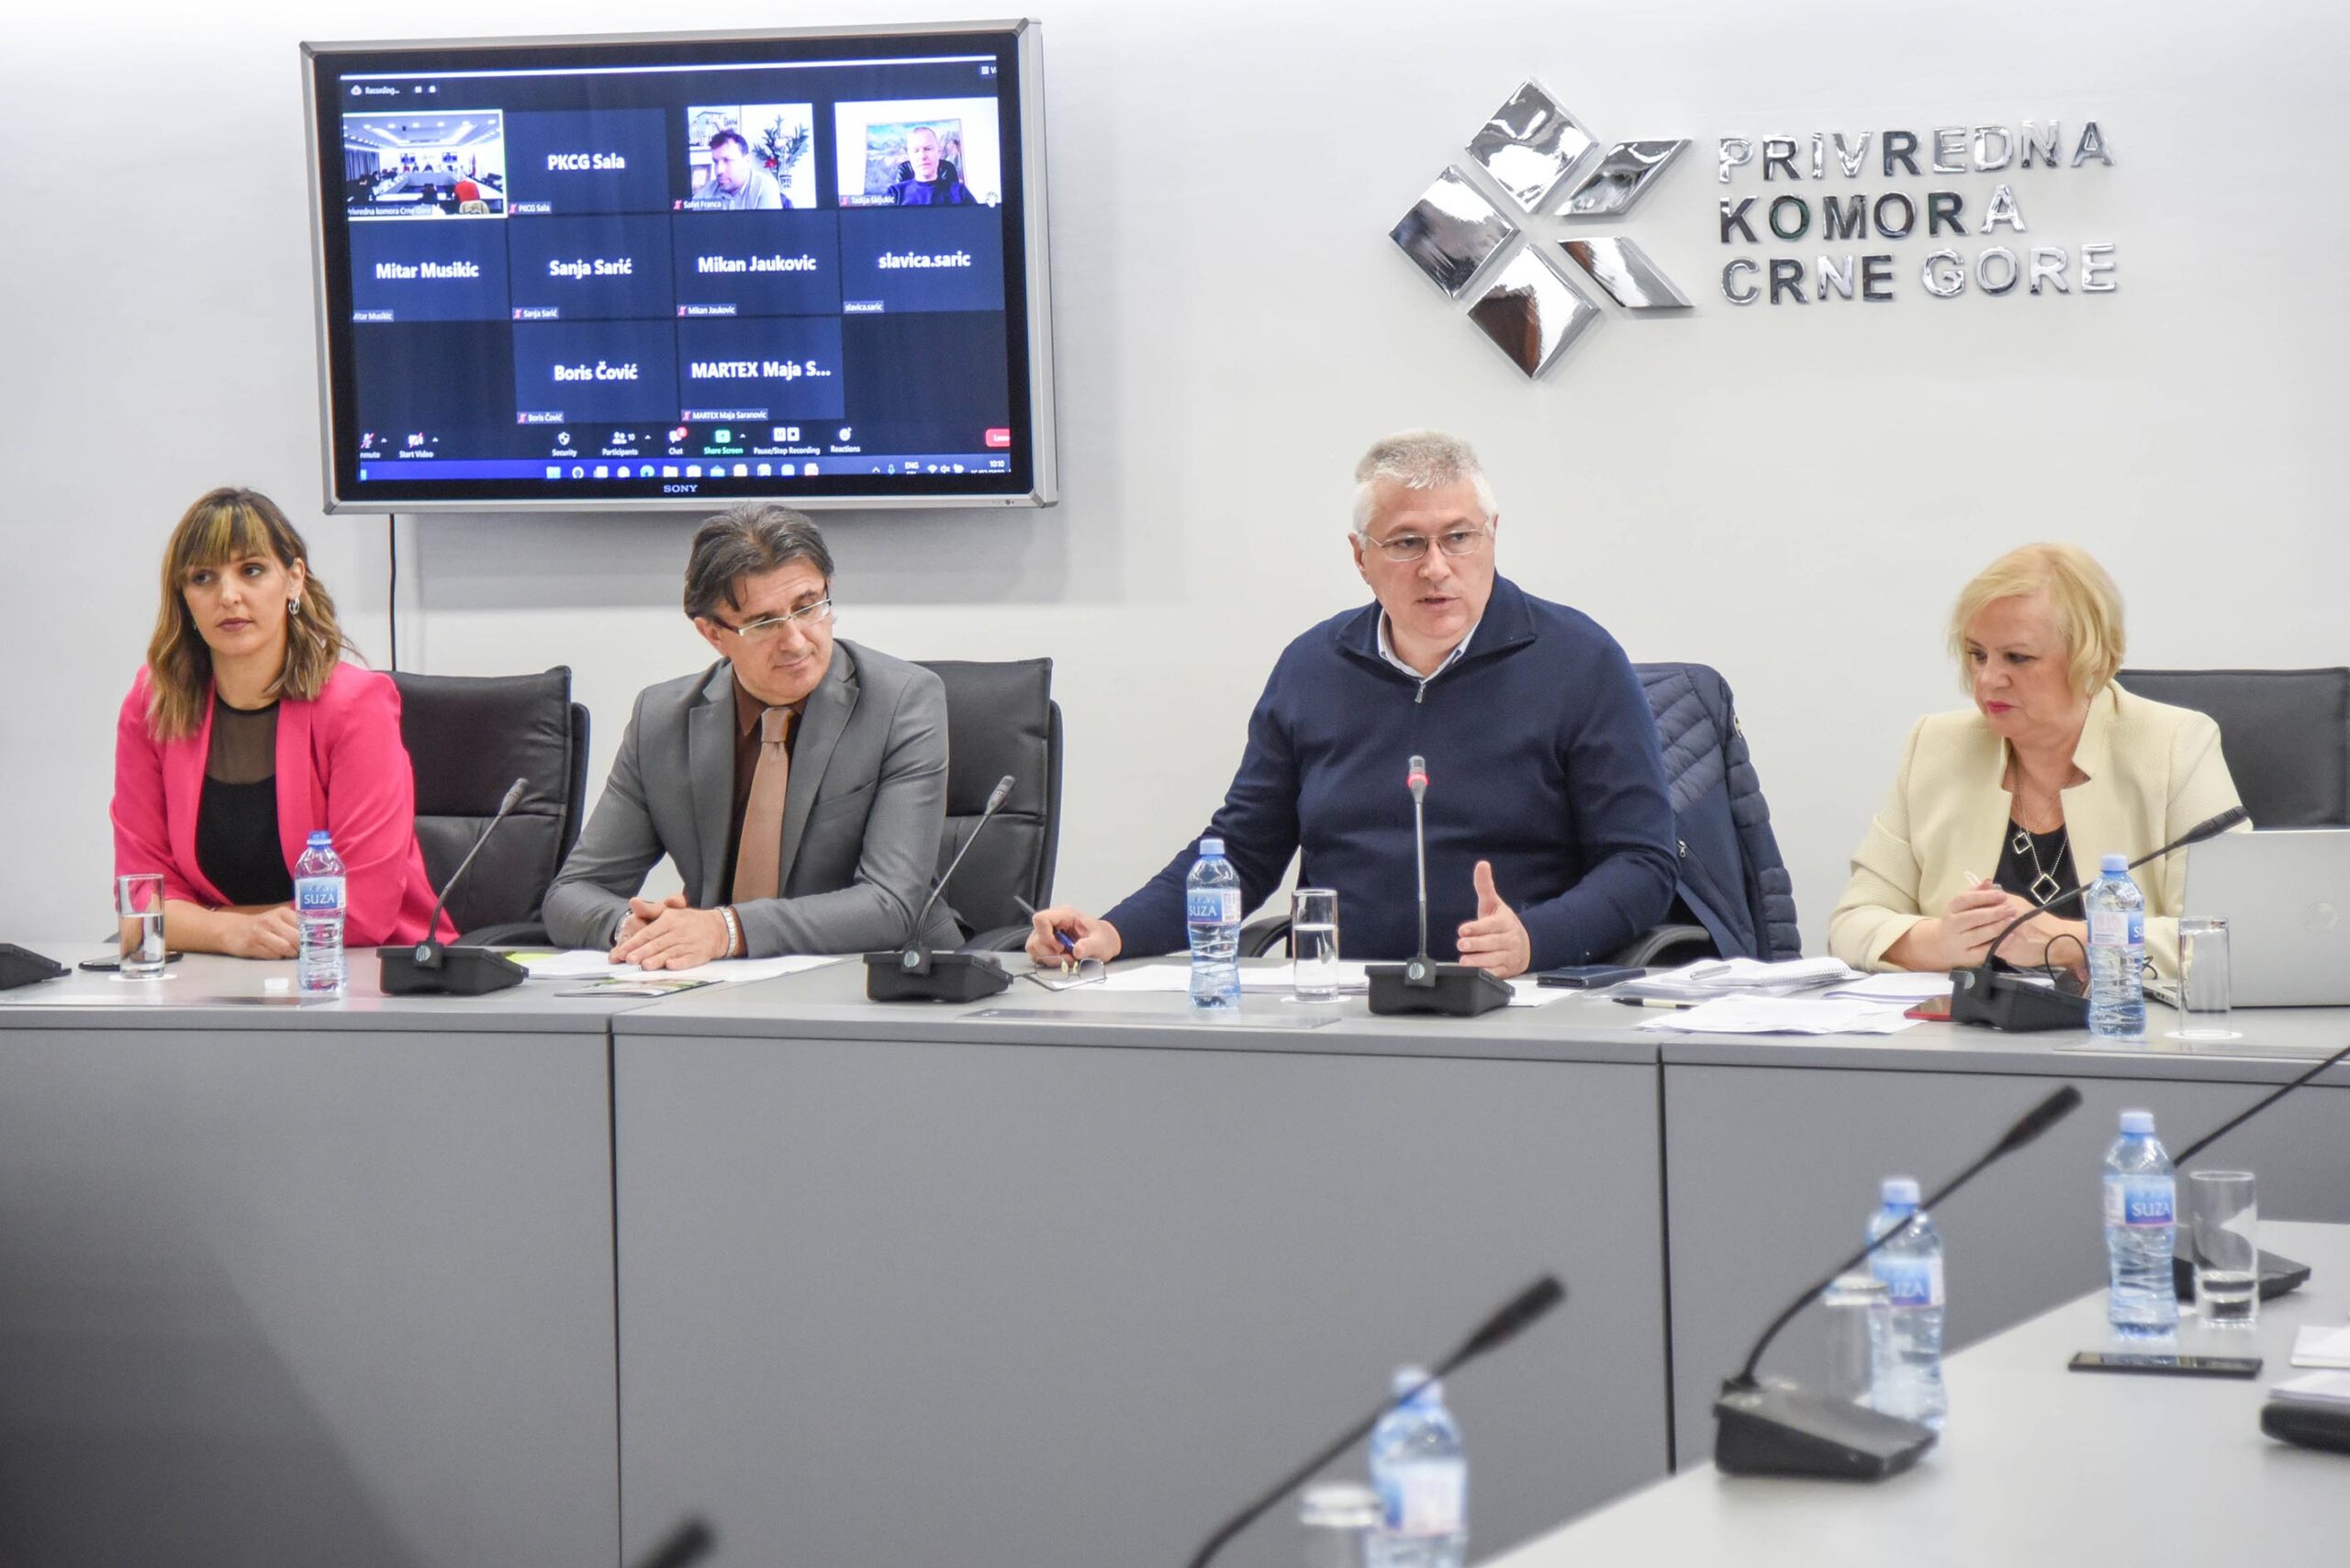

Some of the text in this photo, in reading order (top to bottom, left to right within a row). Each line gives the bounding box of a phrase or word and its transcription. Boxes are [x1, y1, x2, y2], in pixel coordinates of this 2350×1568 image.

[1718, 119, 2115, 184] PRIVREDNA
[548, 152, 625, 171] PKCG Sala
[519, 204, 551, 212] PKCG Sala
[1719, 185, 2027, 243] KOMORA
[698, 254, 817, 273] Mikan Jaukovic
[878, 251, 971, 268] slavica.saric
[375, 261, 479, 279] Mitar Musikic
[549, 258, 632, 279] Sanja Sarić
[1720, 242, 2117, 306] CRNE GORE
[523, 308, 542, 319] Sanja
[688, 306, 708, 314] Mikan
[554, 361, 638, 381] Boris Čović
[691, 362, 758, 379] MARTEX
[764, 361, 801, 381] Maja
[528, 413, 544, 422] Boris
[692, 411, 719, 420] MARTEX
[720, 411, 735, 420] Maja
[399, 450, 434, 458] Start Video
[552, 448, 577, 458] Security
[601, 448, 639, 457] Participants
[668, 447, 683, 455] Chat
[704, 446, 744, 454] Share Screen
[753, 446, 821, 456] Pause/Stop Recording
[830, 445, 861, 454] Reactions
[904, 461, 919, 469] ENG
[663, 485, 698, 493] SONY
[304, 893, 335, 904] SUZA
[1189, 905, 1217, 916] SUZA
[2132, 1202, 2170, 1217] SUZA
